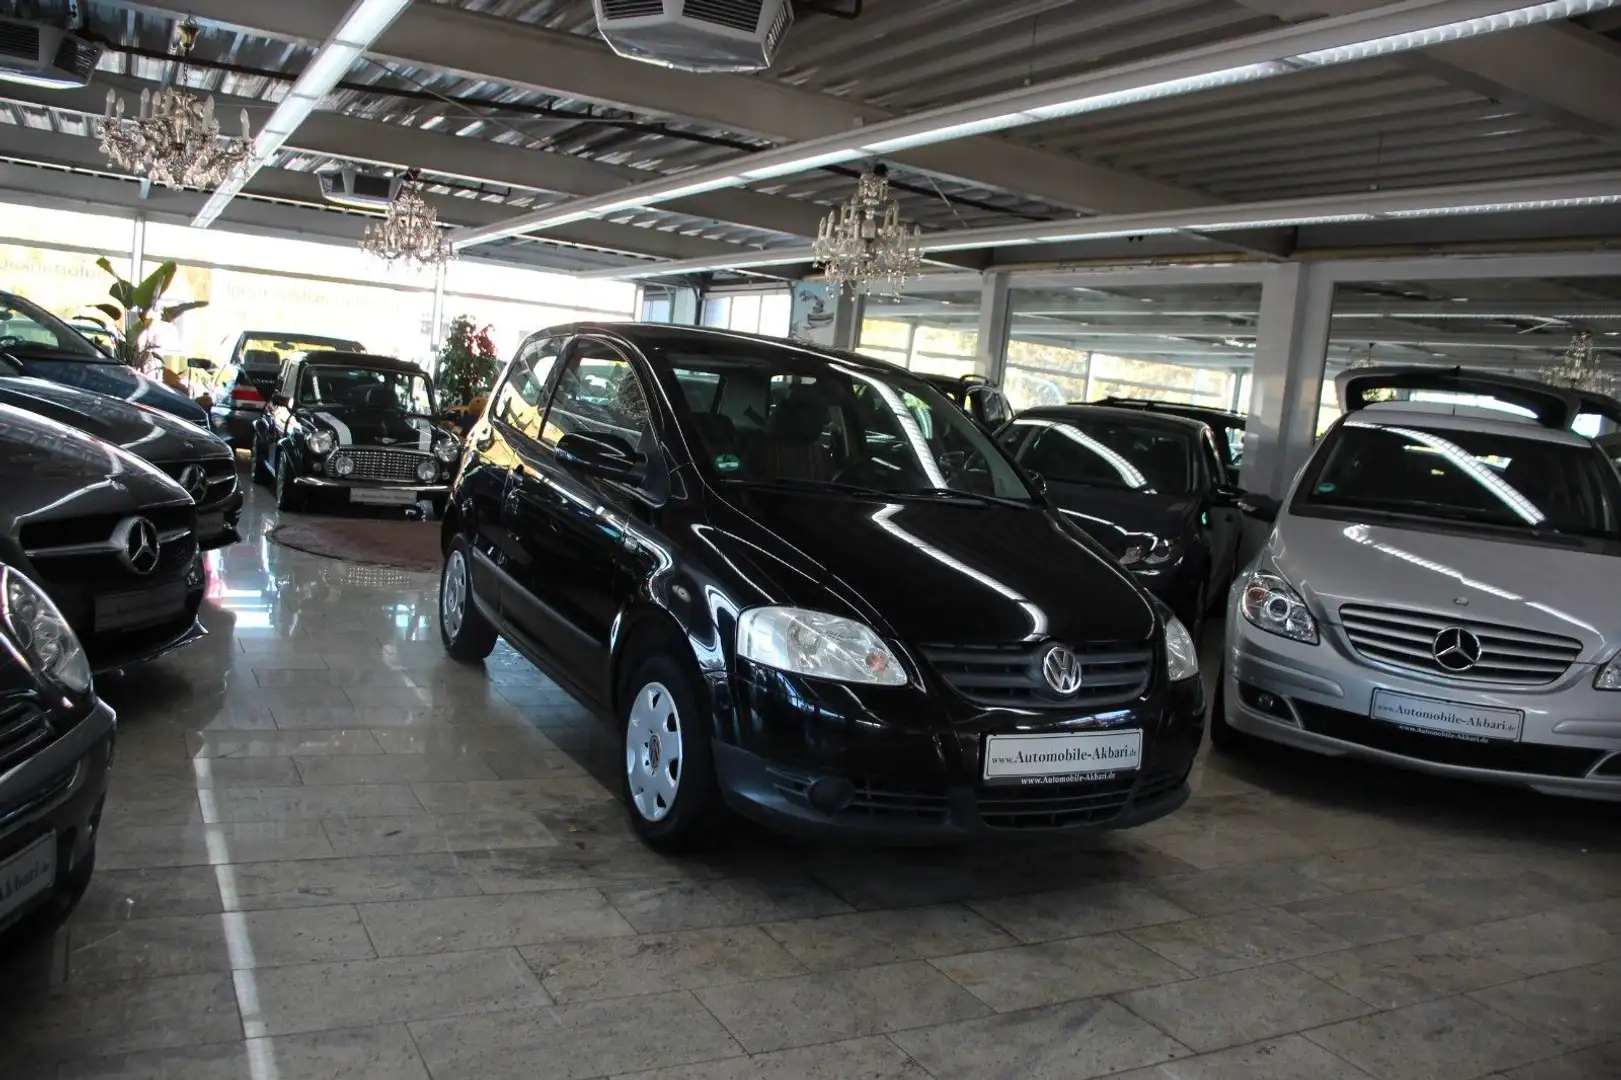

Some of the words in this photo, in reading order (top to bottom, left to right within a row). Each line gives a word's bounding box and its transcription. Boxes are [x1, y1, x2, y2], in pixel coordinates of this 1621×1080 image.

[1377, 703, 1517, 732] www.Automobile-Akbari.de
[991, 744, 1137, 764] www.Automobile-Akbari.de
[1020, 771, 1116, 785] www.Automobile-Akbari.de
